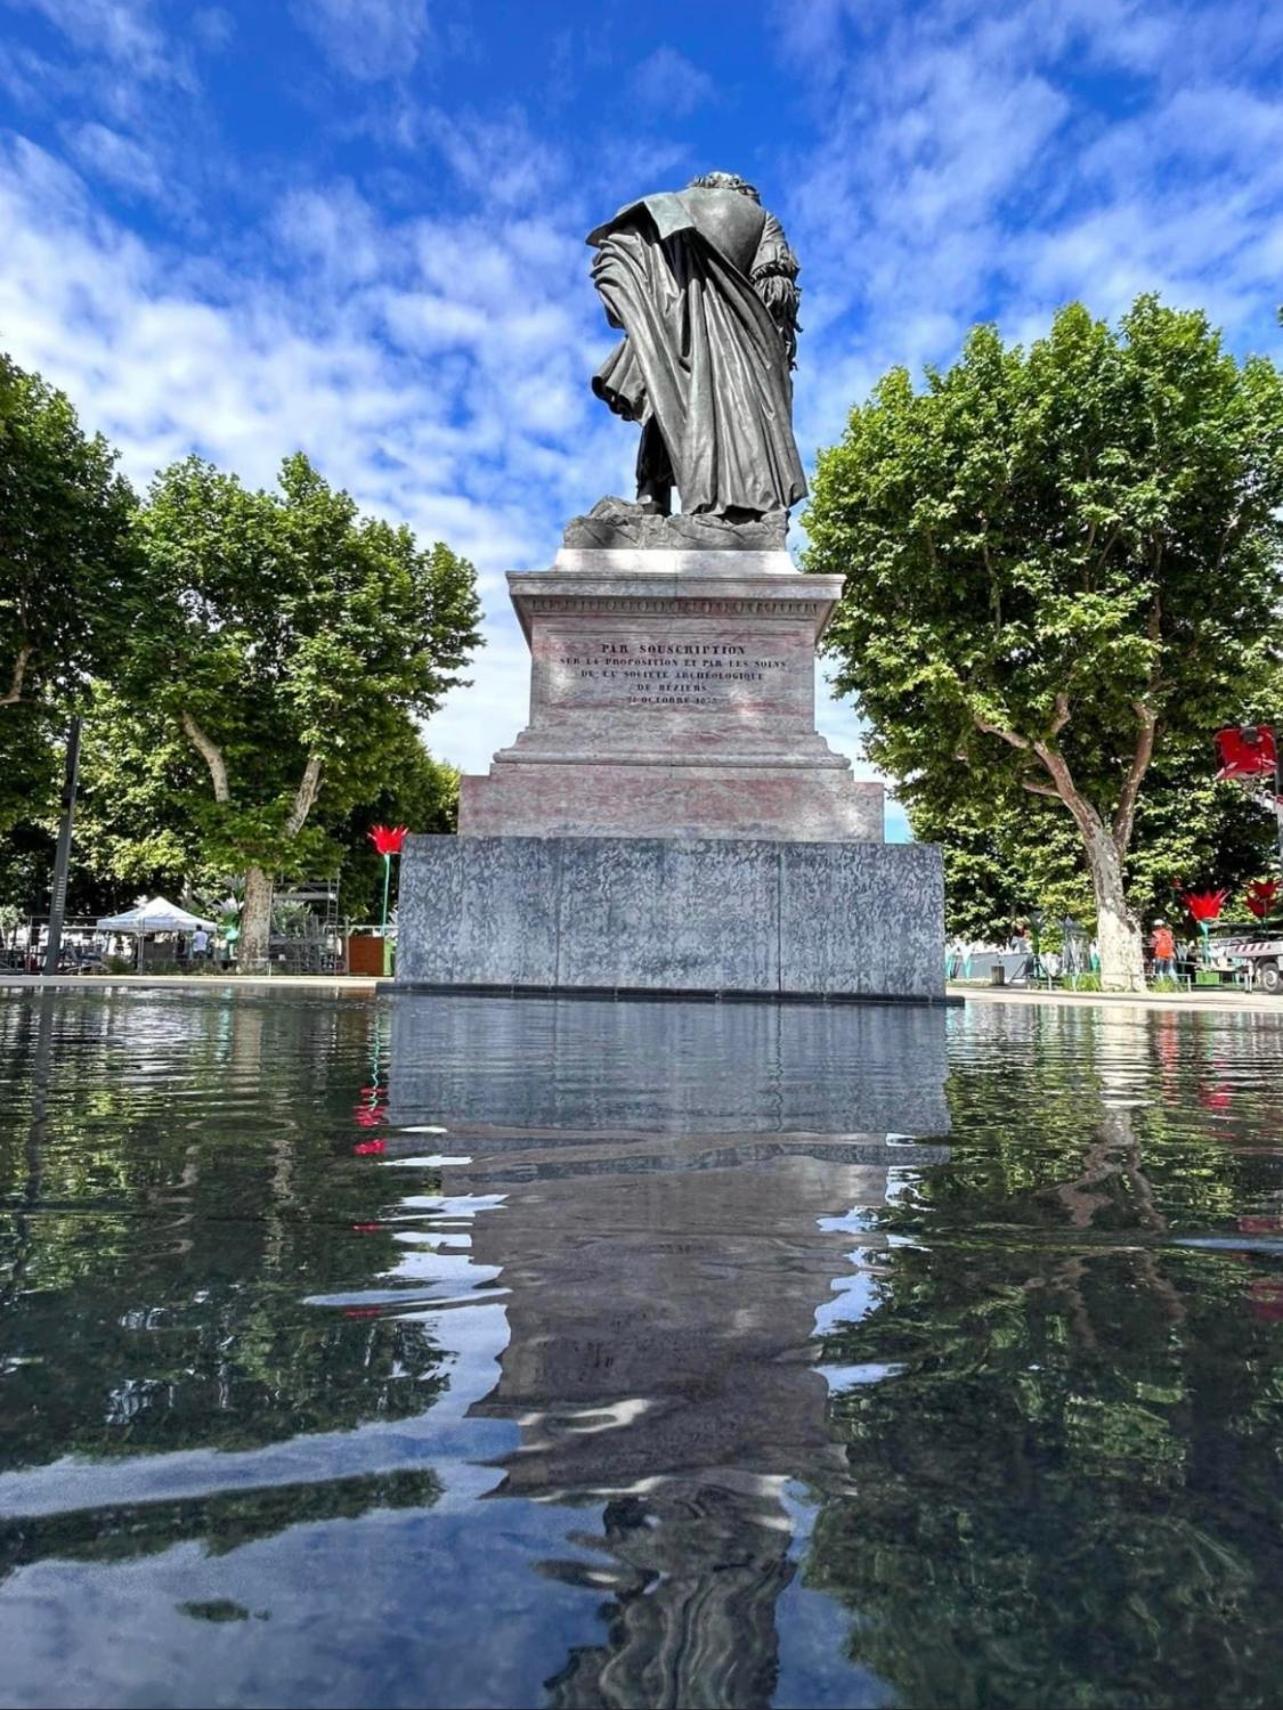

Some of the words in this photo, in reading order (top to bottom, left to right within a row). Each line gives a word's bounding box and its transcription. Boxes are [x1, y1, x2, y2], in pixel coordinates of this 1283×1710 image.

[601, 644, 628, 654] PAR
[640, 644, 744, 654] SOUSCRIPTION
[606, 658, 678, 666] PROPOSITION
